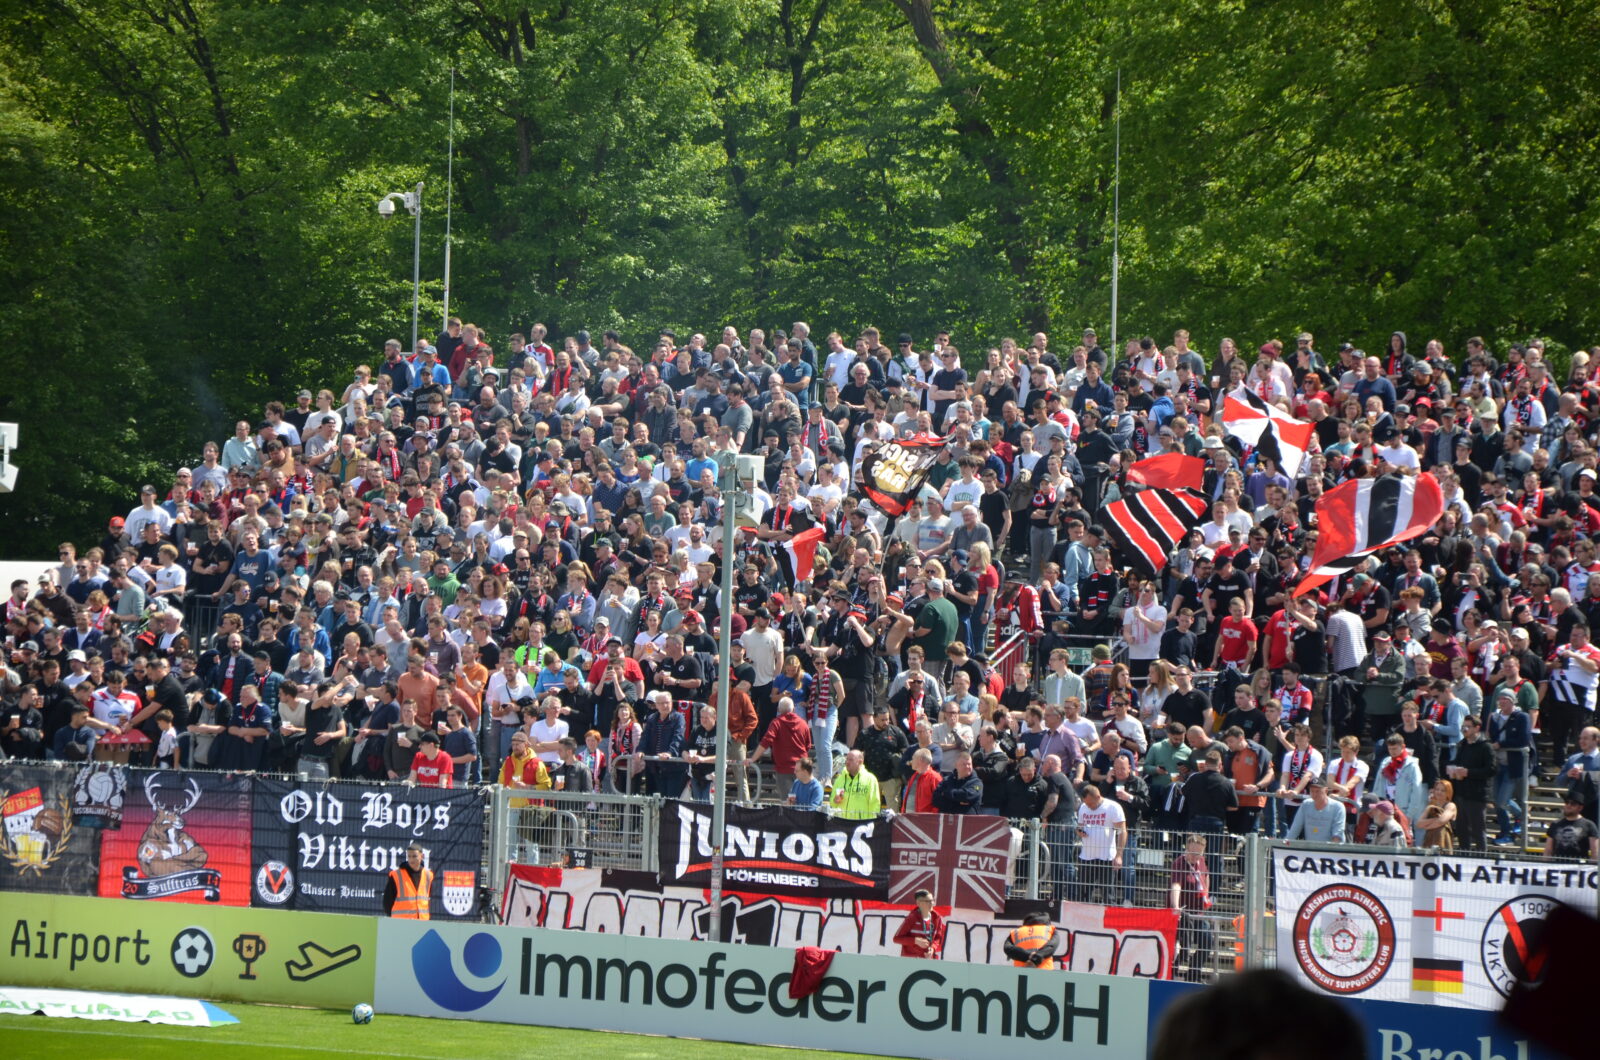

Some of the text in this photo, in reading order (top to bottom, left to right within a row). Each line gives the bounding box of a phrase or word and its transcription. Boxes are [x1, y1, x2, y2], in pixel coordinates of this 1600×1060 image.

[280, 789, 451, 837] Old Boys
[298, 832, 432, 872] Viktora
[676, 804, 875, 879] JUNIORS
[726, 868, 820, 888] HÖHENBERG
[958, 854, 999, 873] FCVK
[1283, 855, 1462, 883] CARSHALTON
[124, 882, 138, 894] 20
[301, 882, 375, 899] Unsere Heimat
[1302, 889, 1388, 925] CARSHALTON ATHLETIC
[10, 919, 151, 972] Airport
[1298, 939, 1390, 989] INDEPENDENT SUPPORTERS CLUB
[1487, 938, 1515, 994] VIKTO
[519, 937, 1110, 1046] Immofeder GmbH
